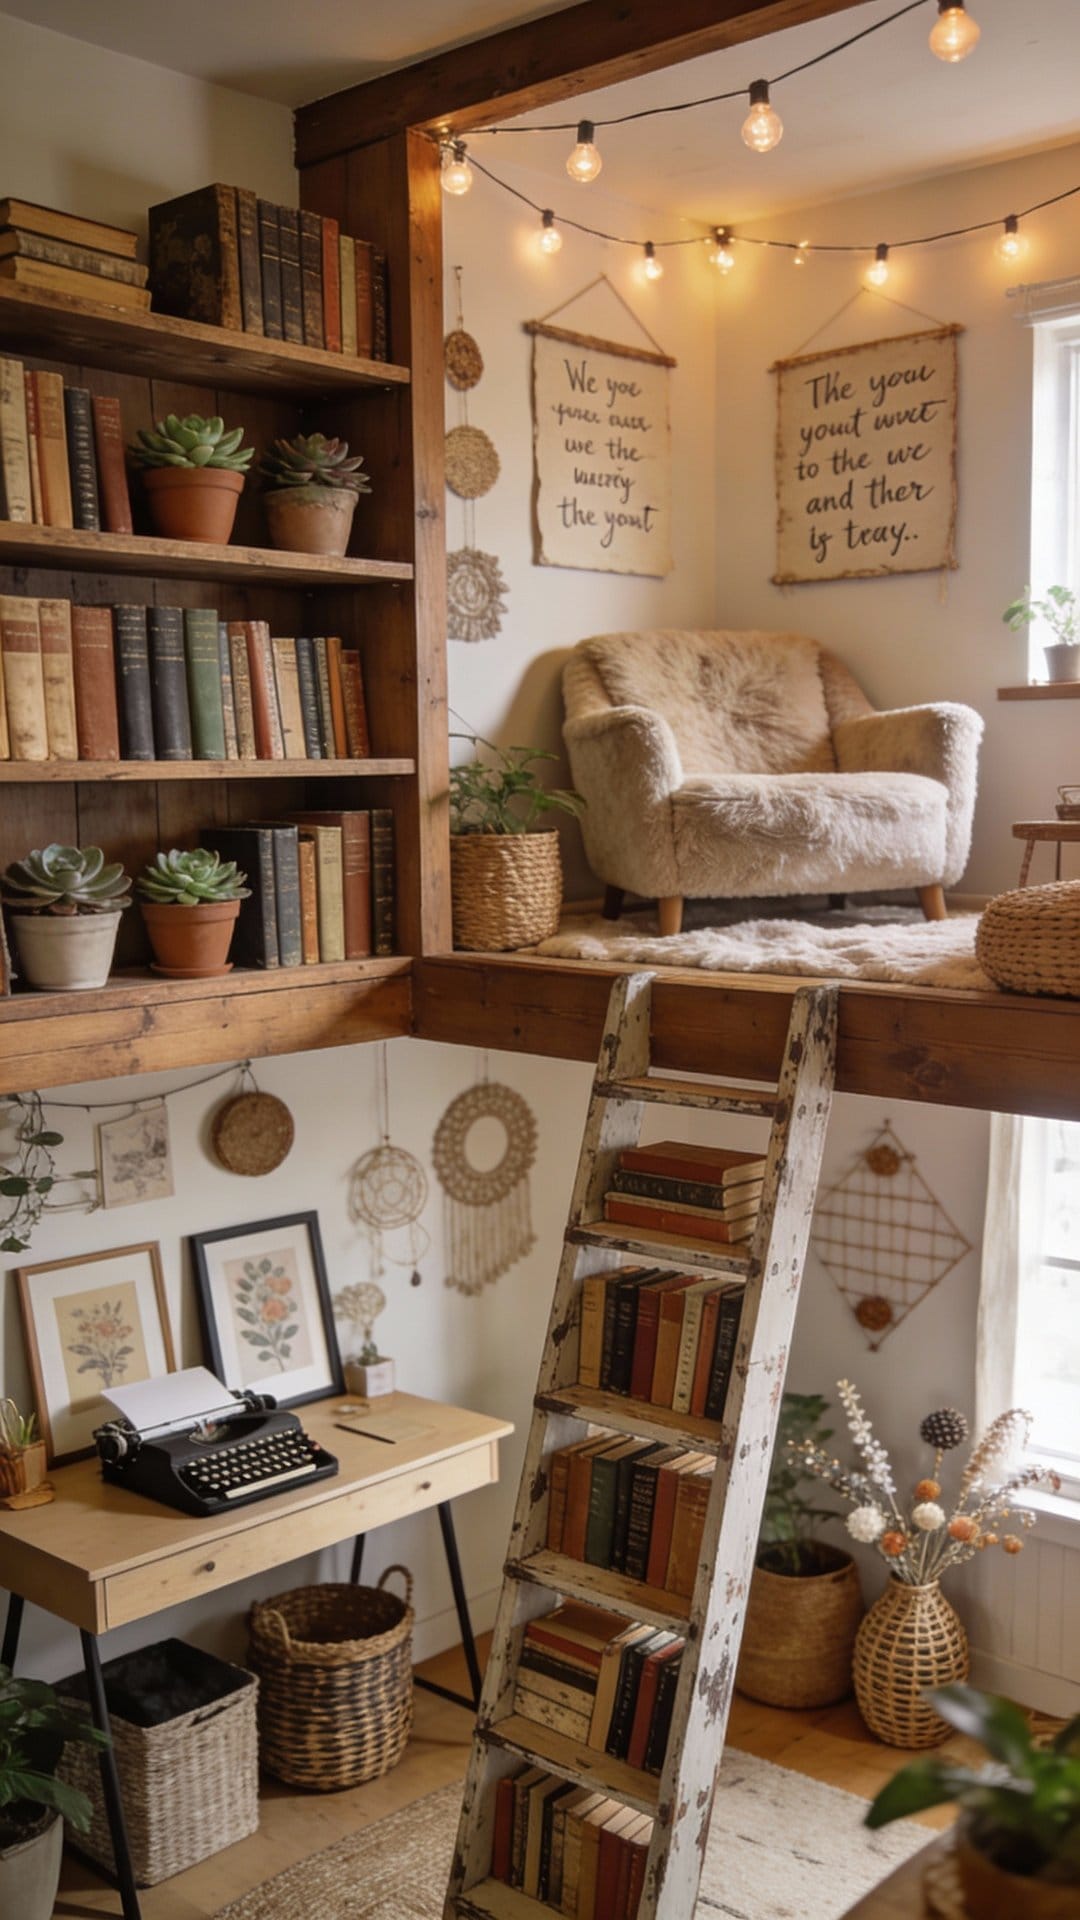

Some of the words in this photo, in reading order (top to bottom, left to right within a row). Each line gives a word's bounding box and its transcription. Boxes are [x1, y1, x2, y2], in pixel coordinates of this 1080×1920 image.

[563, 359, 598, 394] We
[805, 371, 856, 409] The
[604, 436, 647, 462] the
[795, 461, 820, 481] to
[825, 447, 871, 476] the
[806, 479, 854, 515] and
[864, 474, 935, 510] ther
[556, 496, 597, 529] the
